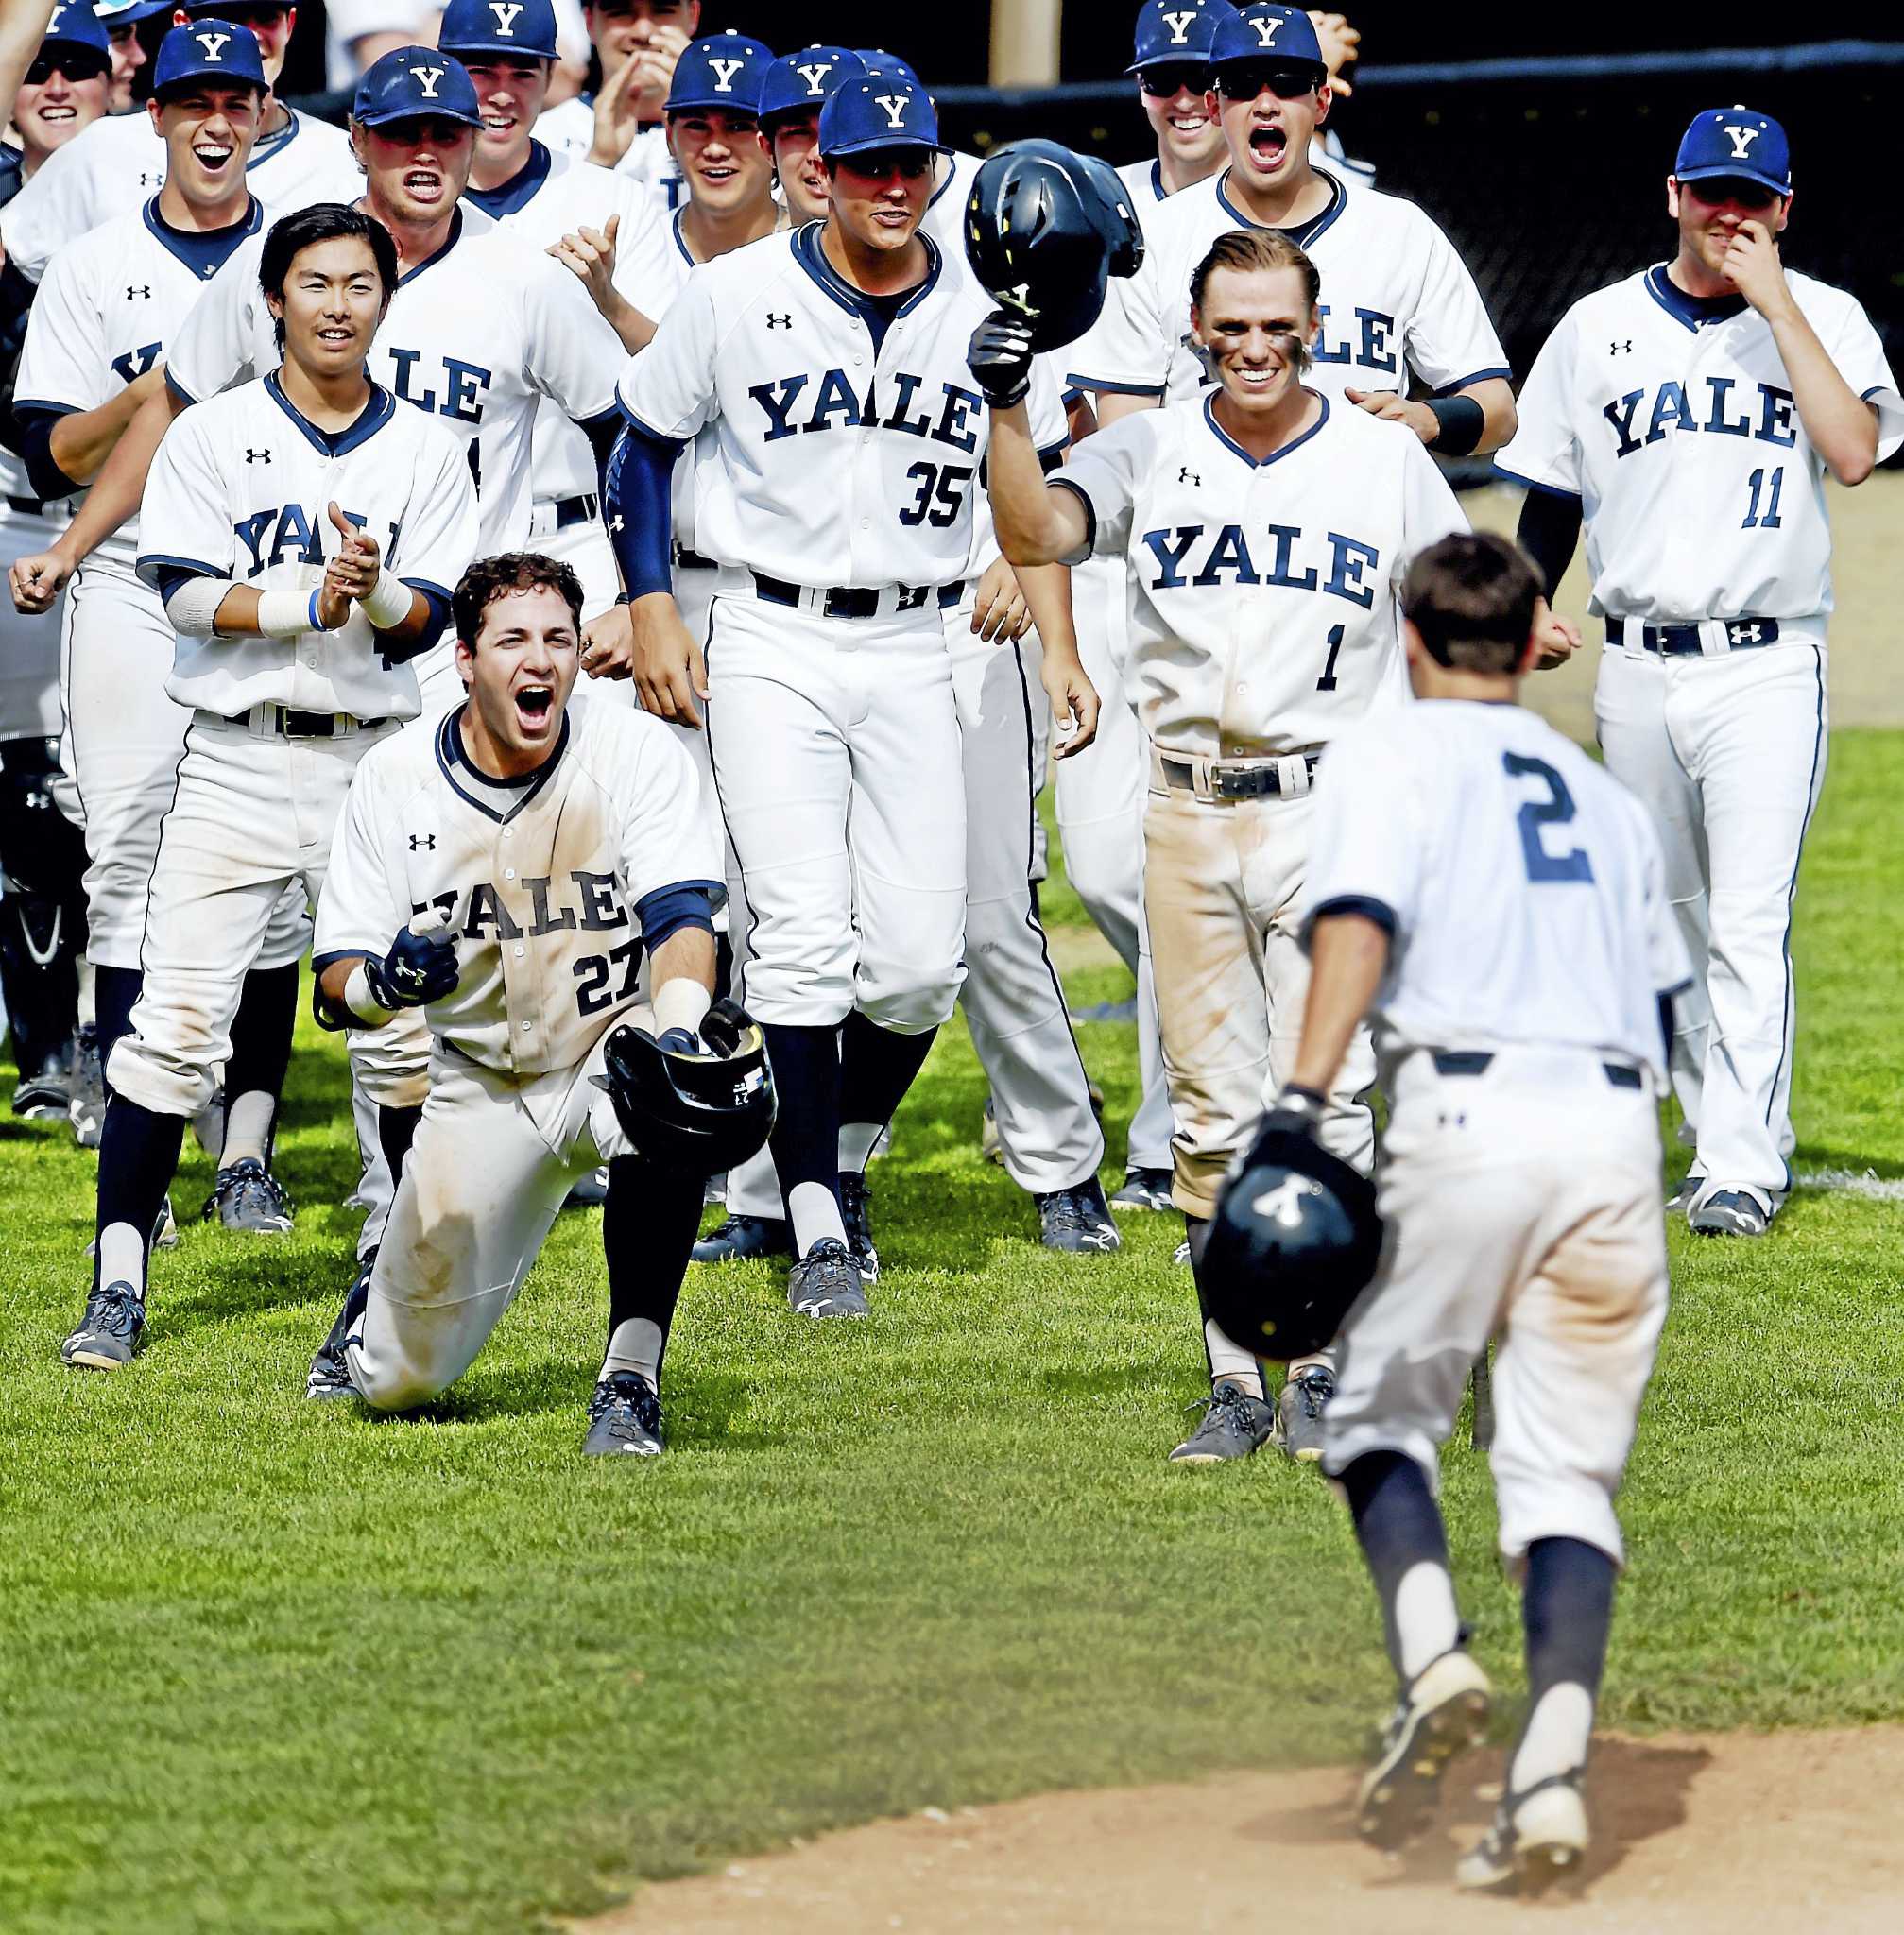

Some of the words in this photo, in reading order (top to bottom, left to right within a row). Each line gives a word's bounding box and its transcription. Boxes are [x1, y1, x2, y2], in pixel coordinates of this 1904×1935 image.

[489, 2, 523, 36] Y
[1162, 11, 1197, 43] Y
[1248, 17, 1283, 46] Y
[196, 33, 231, 61] Y
[410, 66, 444, 97] Y
[708, 59, 744, 92] Y
[797, 64, 832, 95] Y
[874, 95, 909, 128] Y
[1724, 126, 1758, 158] Y
[389, 348, 491, 424] LE
[748, 368, 982, 454] YALE
[1604, 378, 1796, 458] YALE
[899, 461, 974, 527] 35
[1741, 466, 1784, 528] 11
[1141, 524, 1380, 610] YALE
[1316, 624, 1346, 691] 1
[1502, 751, 1594, 883] 2
[573, 936, 643, 1017] 27
